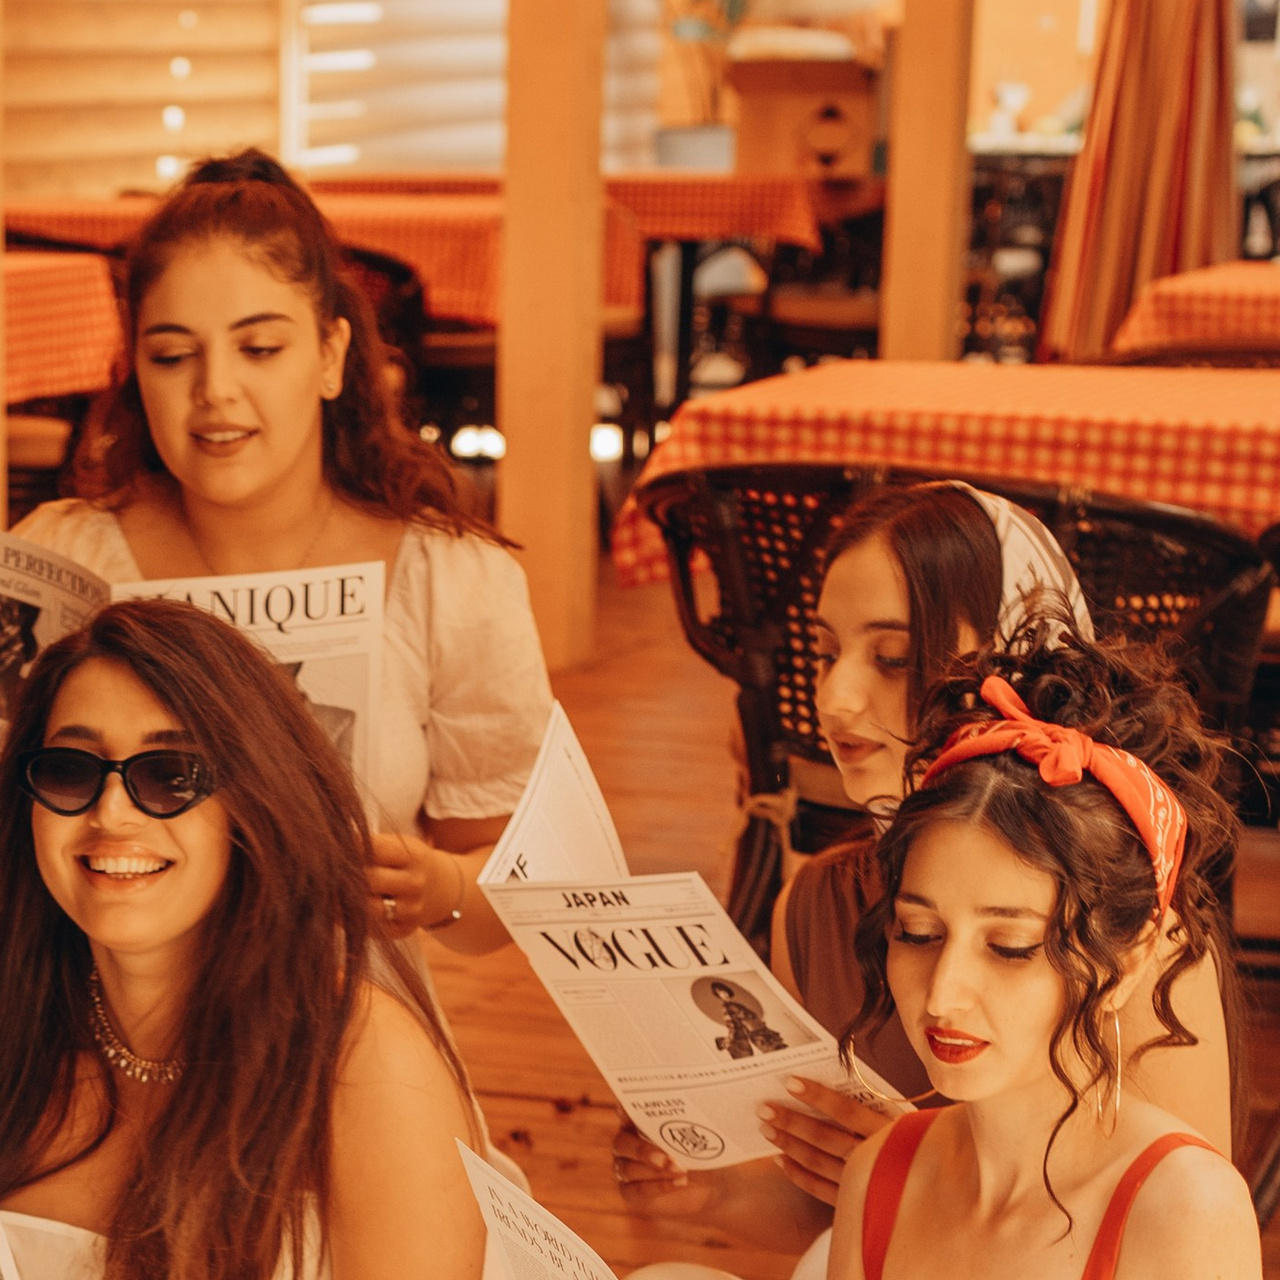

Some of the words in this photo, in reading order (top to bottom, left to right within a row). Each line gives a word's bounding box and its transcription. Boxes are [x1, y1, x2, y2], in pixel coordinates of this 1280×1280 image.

[3, 545, 105, 601] PERFECTION
[562, 890, 630, 909] JAPAN
[539, 923, 731, 973] VOGUE
[630, 1098, 686, 1112] FLAWLESS
[644, 1106, 687, 1119] BEAUTY
[520, 1210, 573, 1262] WORLD
